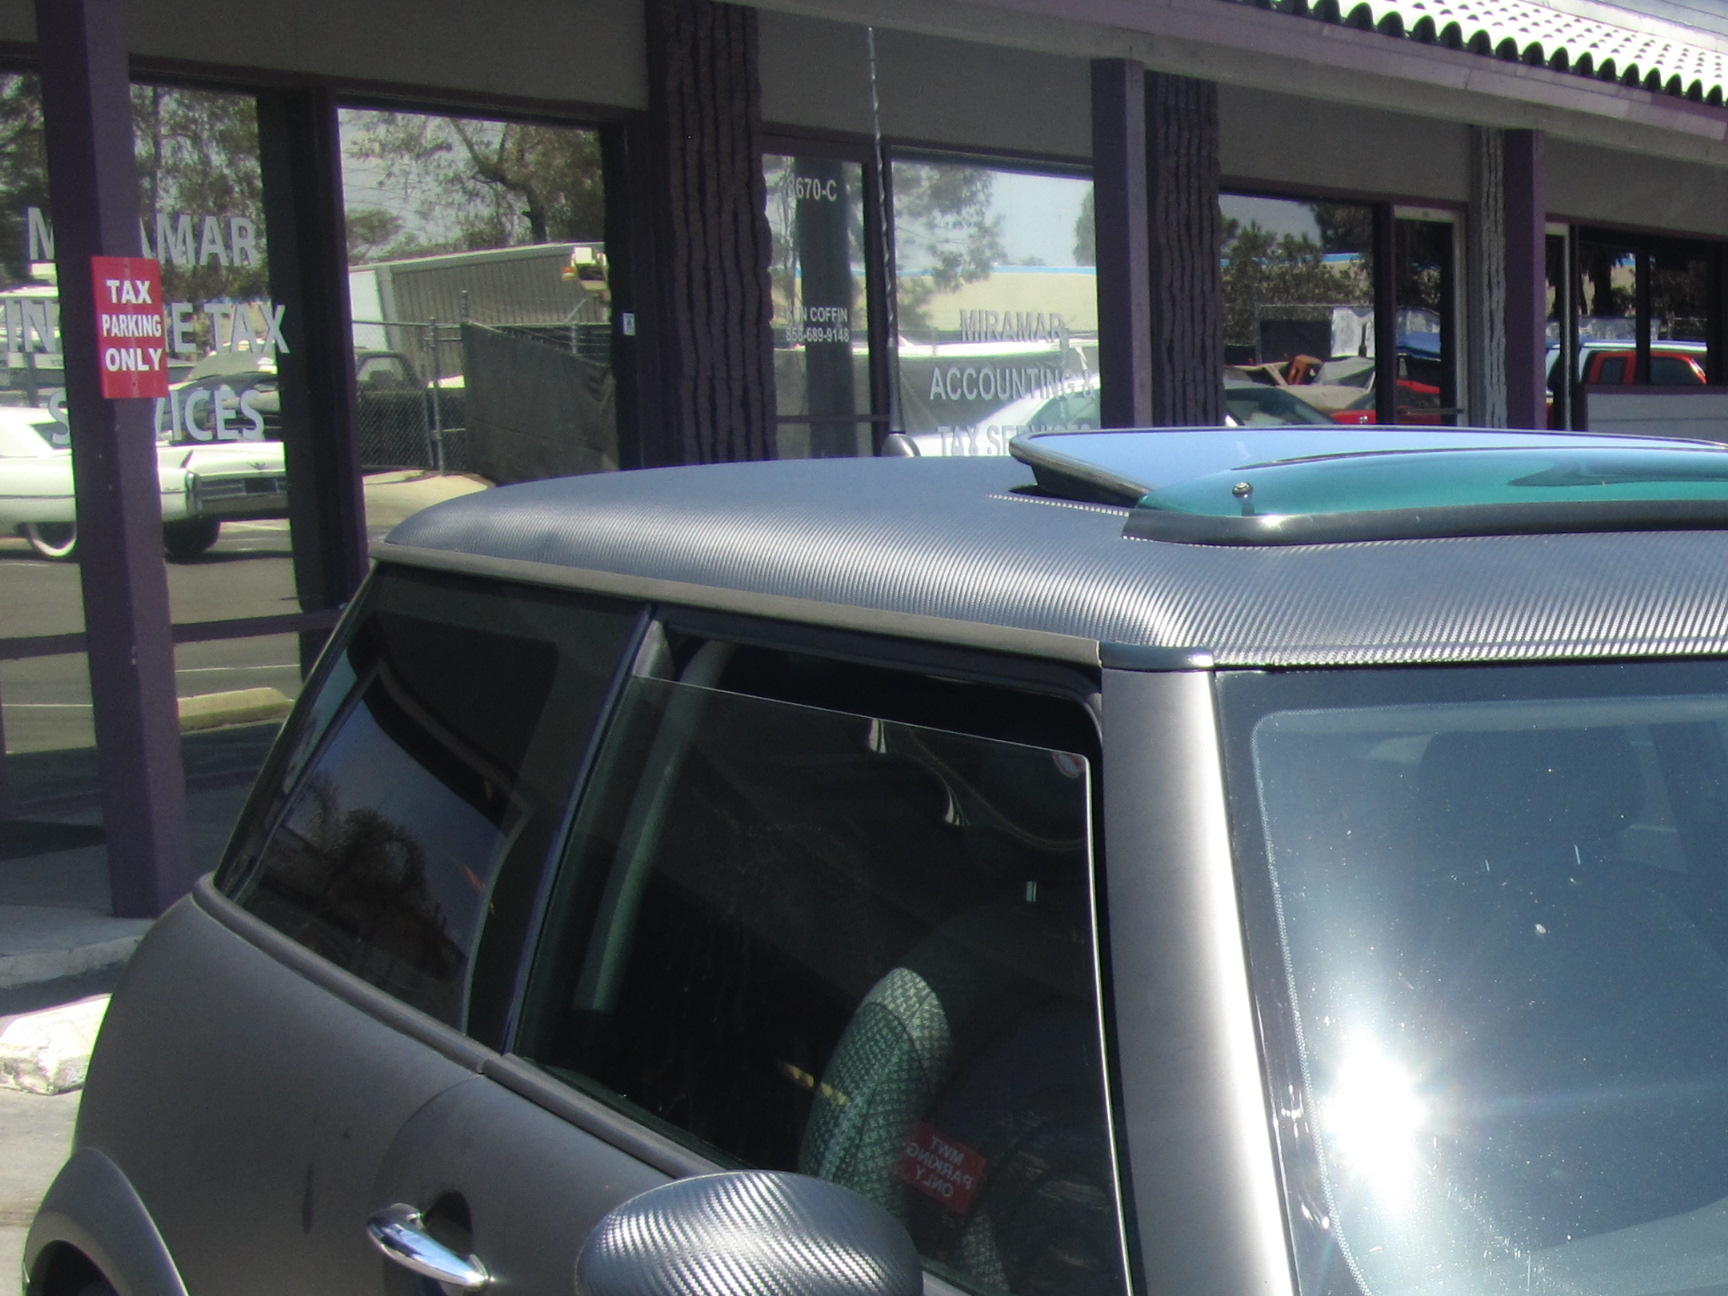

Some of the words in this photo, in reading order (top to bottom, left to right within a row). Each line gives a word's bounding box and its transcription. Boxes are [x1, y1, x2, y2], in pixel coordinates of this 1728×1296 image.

[786, 178, 837, 201] 8670-C
[27, 206, 258, 266] MMAR
[106, 279, 152, 304] TAX
[4, 299, 194, 353] INE
[204, 302, 290, 354] TAX
[102, 314, 162, 337] PARKING
[810, 307, 848, 322] COFFIN
[959, 309, 1064, 342] MIRAMAR
[105, 347, 163, 371] ONLY
[930, 367, 1075, 401] ACCOUNTING
[49, 387, 265, 445] SICES
[937, 424, 980, 456] TAX
